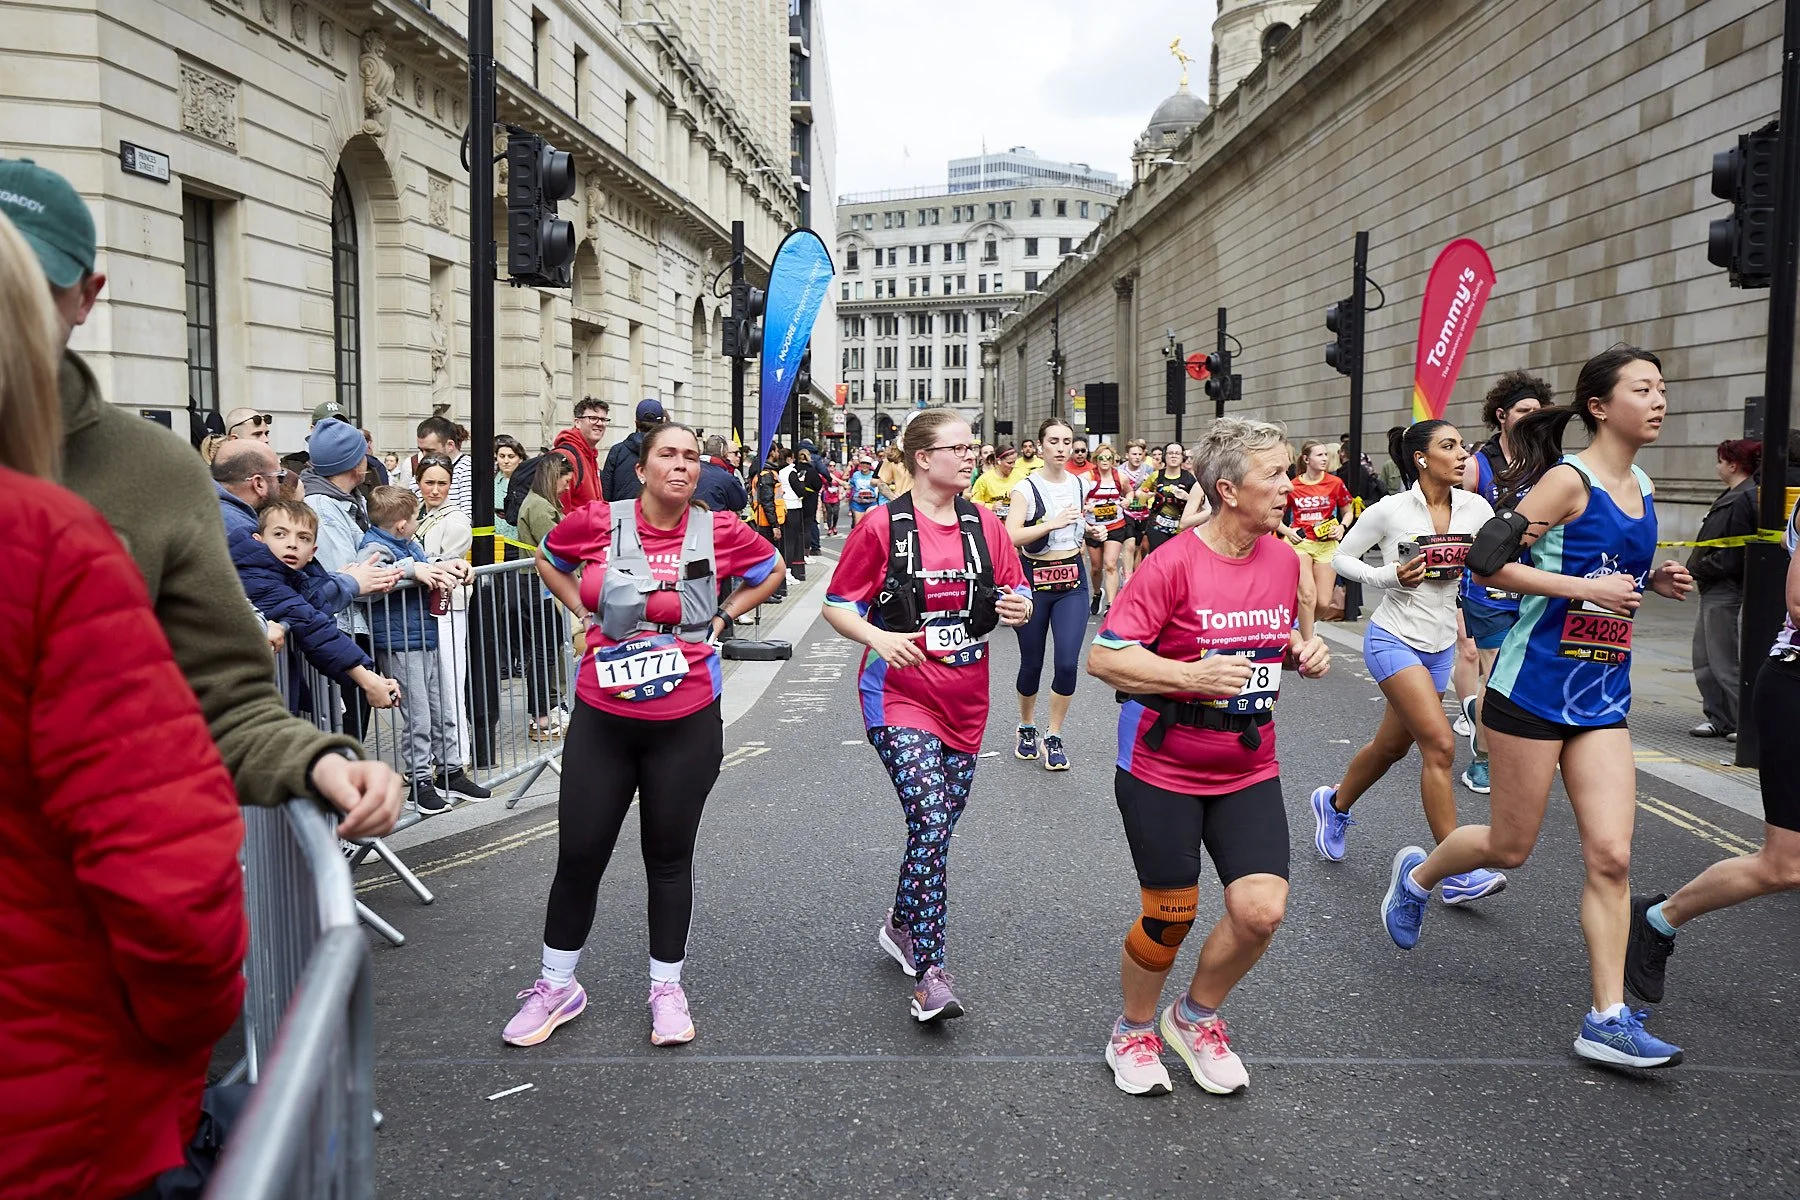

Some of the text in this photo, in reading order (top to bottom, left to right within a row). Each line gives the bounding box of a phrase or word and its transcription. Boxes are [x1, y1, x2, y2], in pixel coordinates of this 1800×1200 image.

[138, 151, 156, 164] PRINCES
[138, 161, 154, 173] STREET
[1426, 267, 1476, 368] Tommy's
[778, 323, 797, 362] MOORE
[1037, 567, 1075, 581] 17091
[927, 590, 959, 600] pregnancy
[1196, 604, 1291, 630] Tommy's
[1567, 616, 1629, 644] 24282
[625, 640, 652, 652] STEPH
[1196, 637, 1211, 645] The
[1211, 634, 1248, 646] pregnancy
[1247, 633, 1260, 641] and
[1260, 632, 1277, 642] baby
[605, 651, 679, 684] 11777
